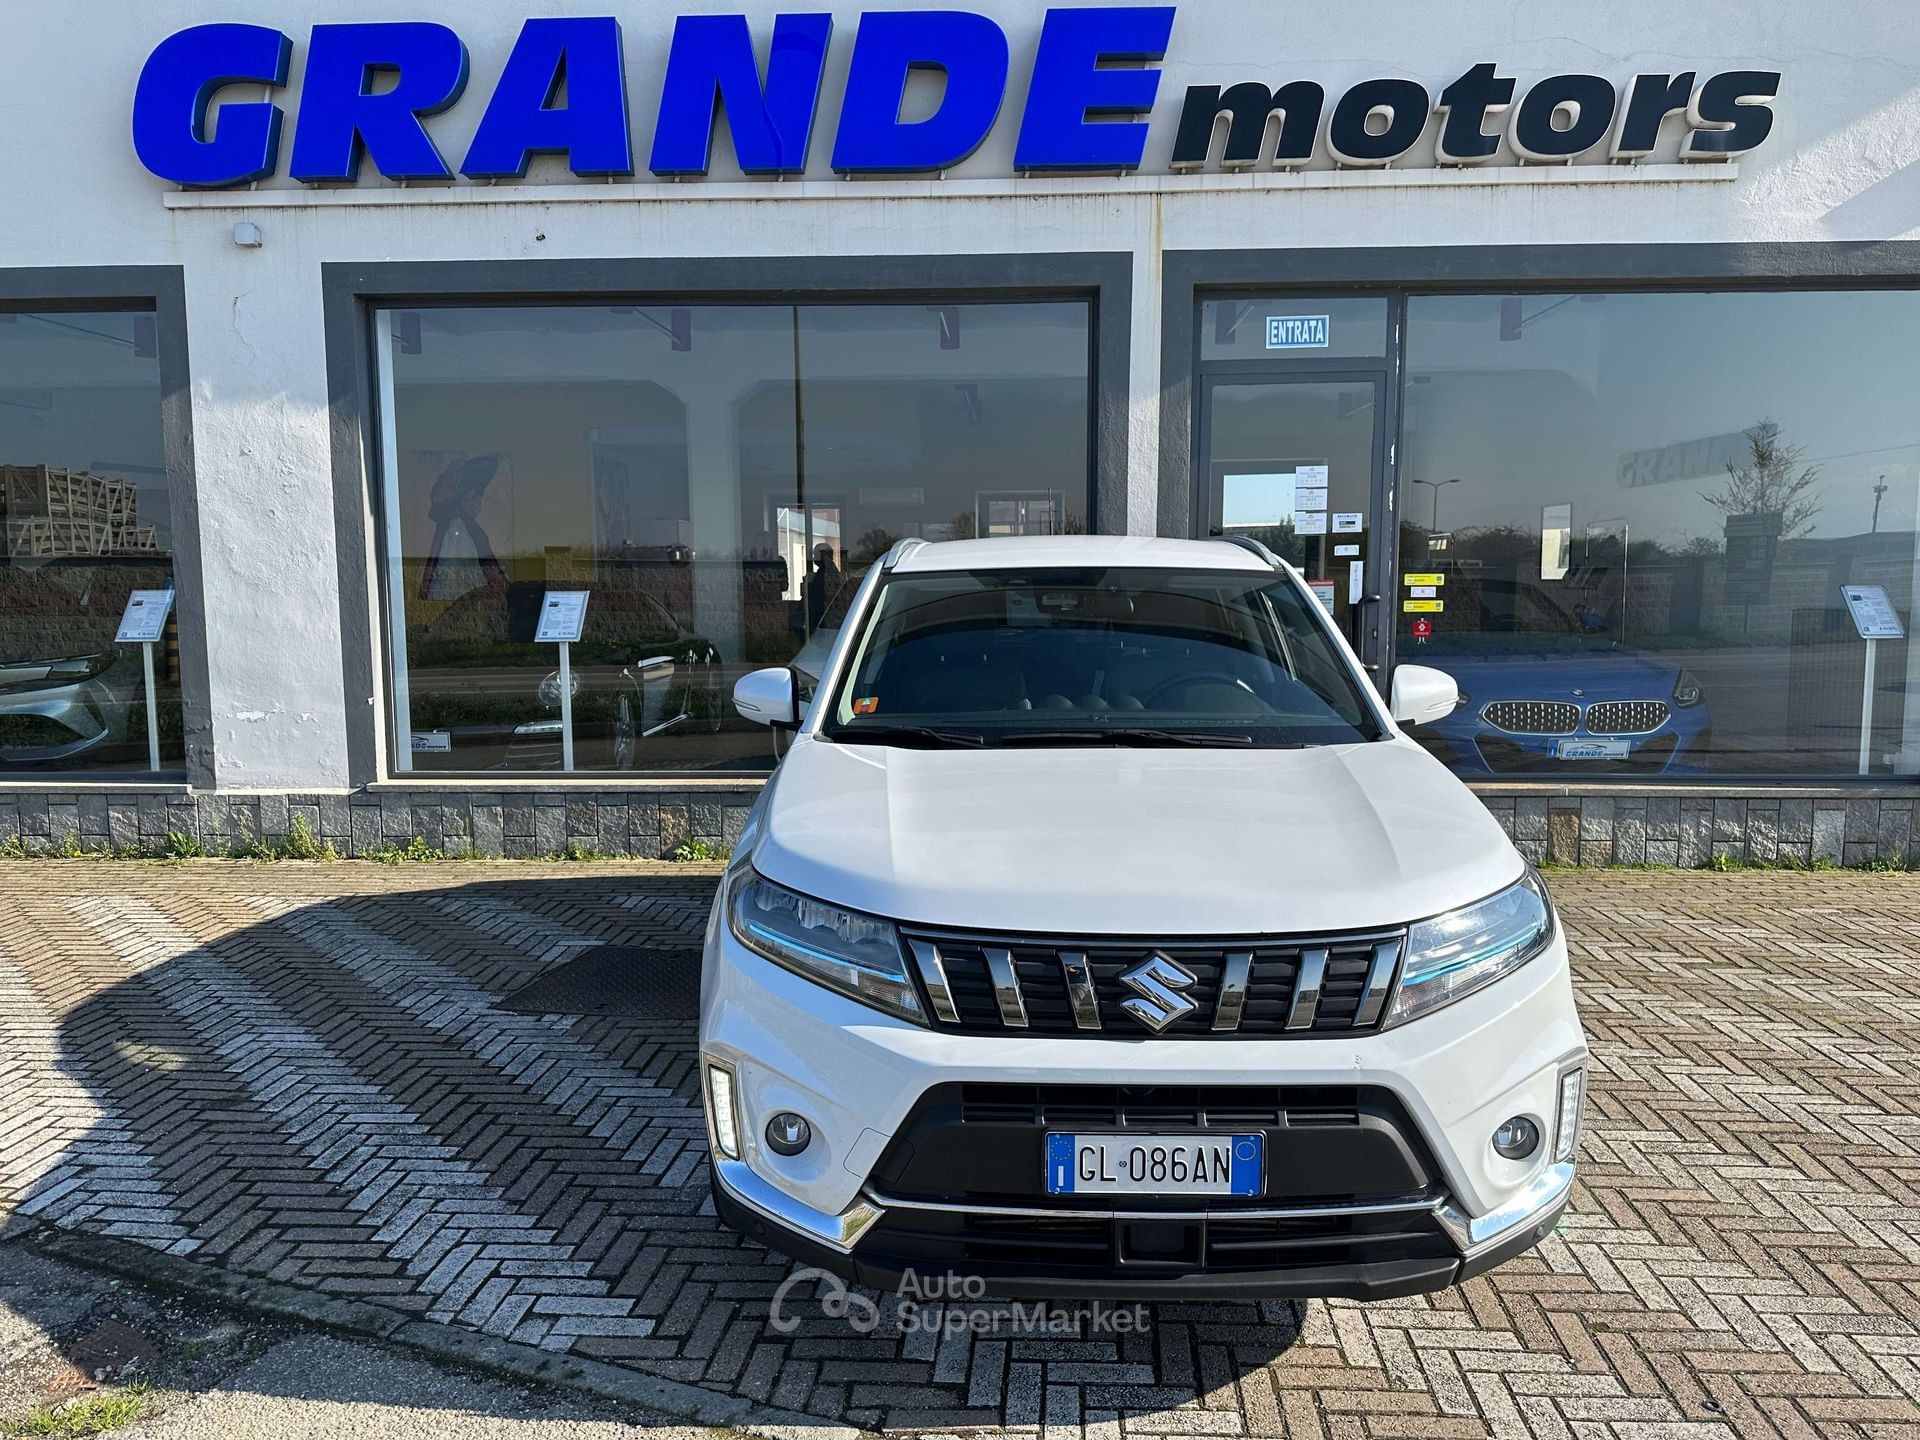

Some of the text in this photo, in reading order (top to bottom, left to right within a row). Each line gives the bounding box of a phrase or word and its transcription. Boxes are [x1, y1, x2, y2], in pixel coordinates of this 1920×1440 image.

[132, 7, 1781, 187] GRANDE motors
[1271, 320, 1324, 344] ENTRATA
[1079, 1146, 1231, 1183] GL 086AN
